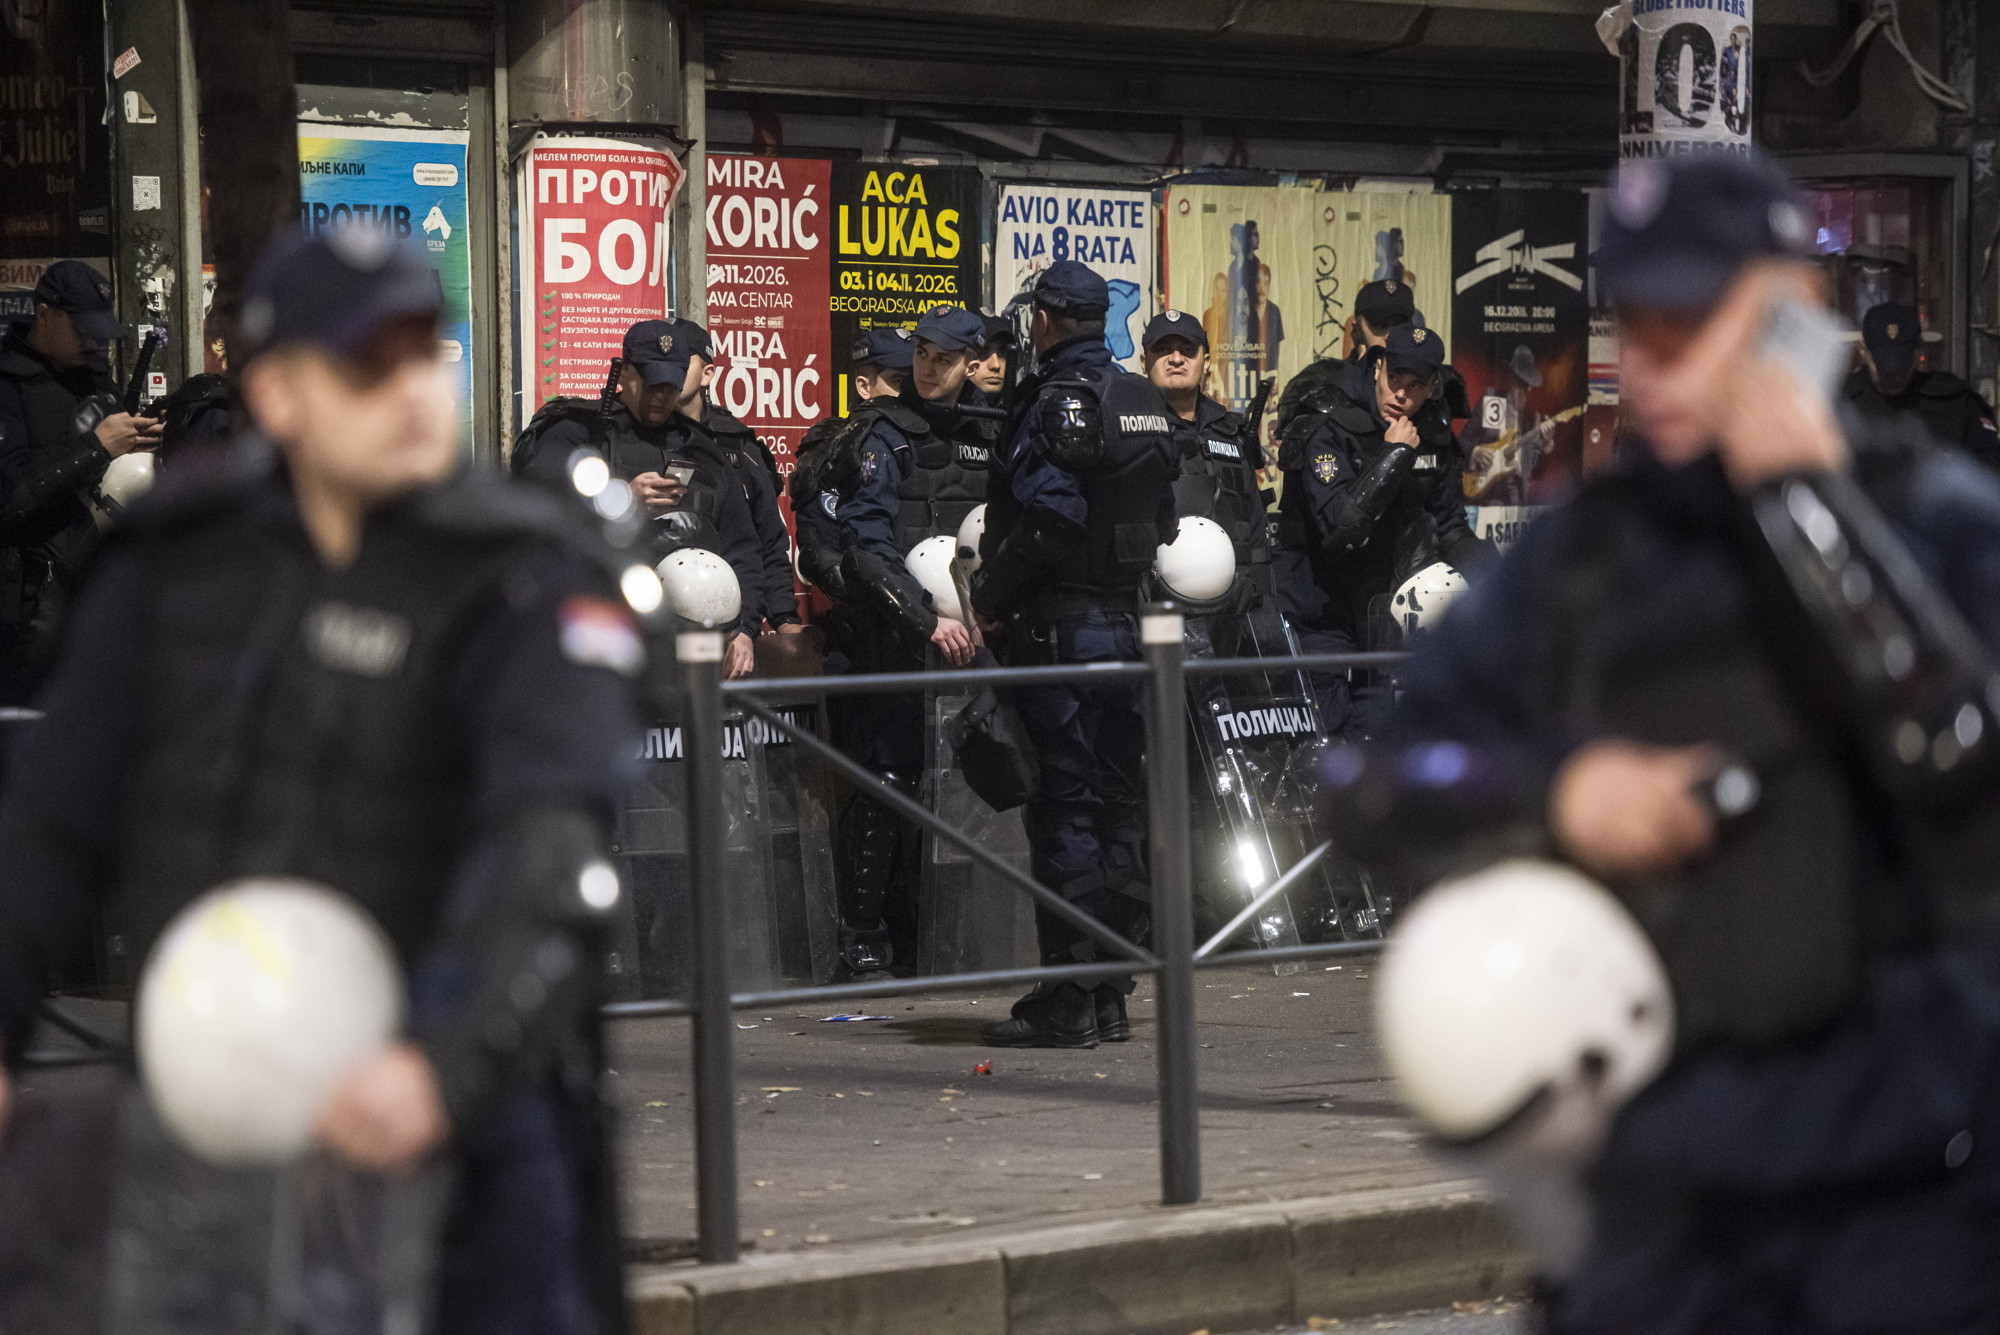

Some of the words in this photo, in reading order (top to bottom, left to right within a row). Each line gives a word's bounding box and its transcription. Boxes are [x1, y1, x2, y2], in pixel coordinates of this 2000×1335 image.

[534, 153, 568, 162] МЕЛЕМ
[570, 154, 606, 162] ПРОТИВ
[608, 155, 629, 163] БОЛА
[637, 156, 644, 164] ЗА
[333, 162, 365, 176] КАПИ
[708, 158, 785, 190] MIRA
[861, 171, 928, 205] ACA
[1002, 195, 1059, 224] AVIO
[1067, 198, 1144, 228] KARTE
[839, 204, 960, 260] LUKAS
[1013, 232, 1046, 260] NA
[1052, 226, 1069, 261] 8
[1074, 235, 1136, 264] RATA
[839, 271, 865, 290] 03.
[868, 270, 873, 291] i
[876, 272, 912, 292] 04.11.
[915, 274, 958, 294] 2026.
[583, 293, 621, 301] ПРИРОДАН
[739, 291, 793, 309] CENTAR
[830, 296, 916, 314] BEOGRADSKA
[576, 306, 600, 314] НАФТЕ
[608, 307, 632, 315] ДРУГИХ
[561, 316, 602, 325] САСТОЈАКА
[603, 317, 619, 325] КОЈИ
[620, 317, 636, 325] ТРУЈУ
[710, 330, 787, 359] MIRA
[1216, 343, 1266, 351] NOVEMBAR
[559, 358, 603, 366] ЕКСТРЕМНО
[1488, 403, 1500, 423] 3
